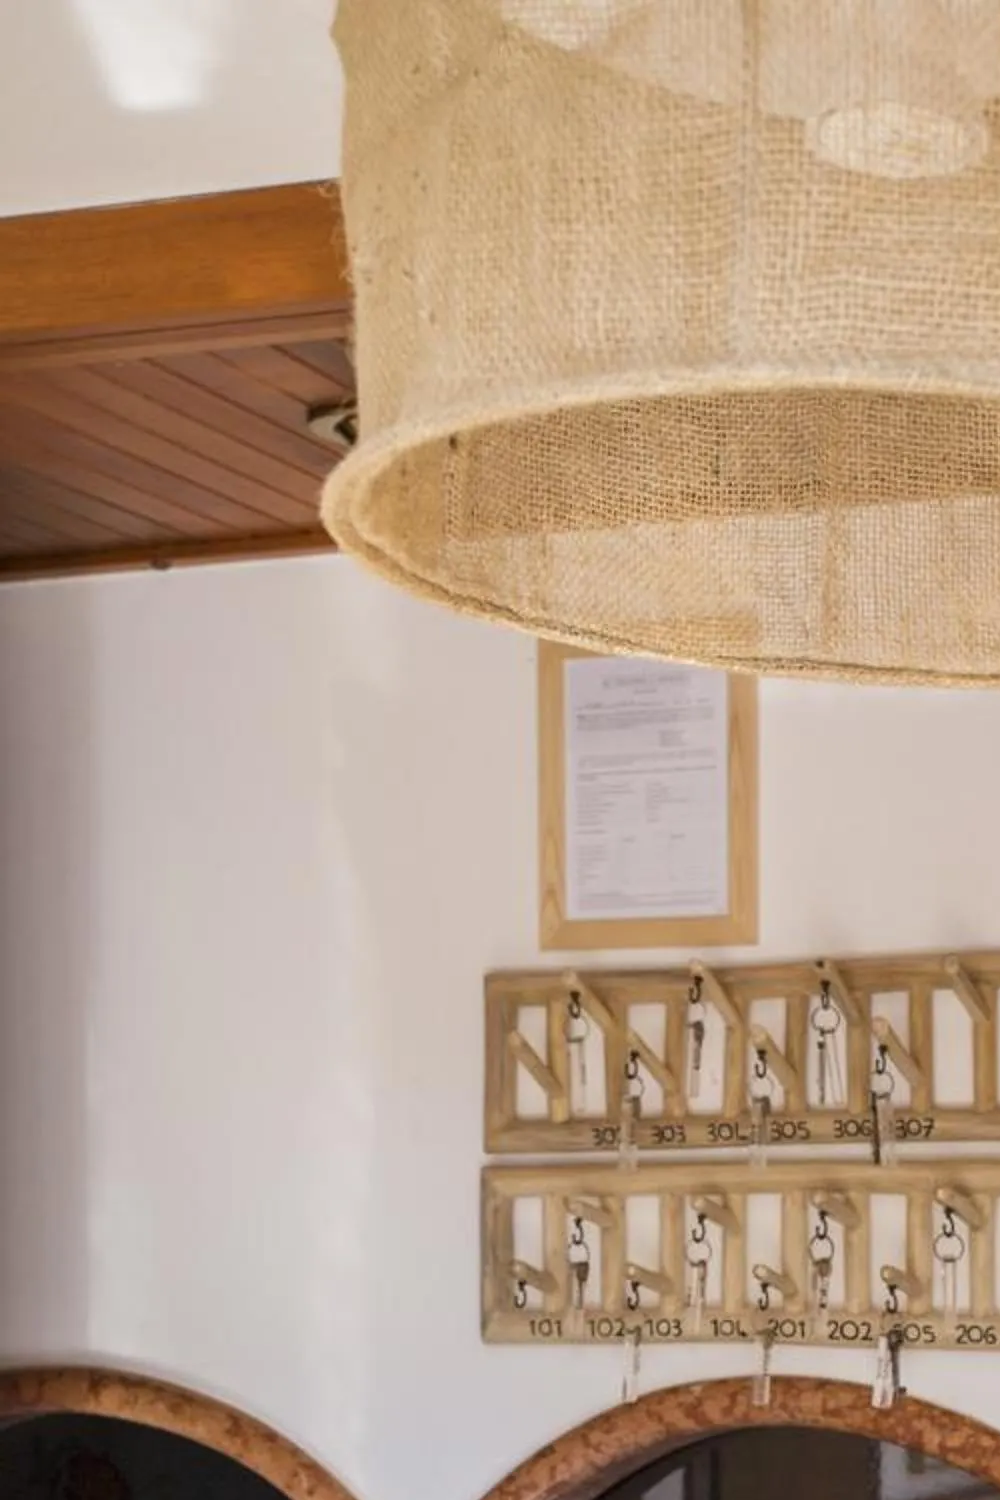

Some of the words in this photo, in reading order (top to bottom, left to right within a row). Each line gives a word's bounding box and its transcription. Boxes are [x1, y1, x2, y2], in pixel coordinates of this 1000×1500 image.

[591, 1126, 622, 1147] 30
[651, 1123, 686, 1144] 303
[771, 1119, 811, 1141] 305
[833, 1118, 876, 1139] 306
[895, 1117, 936, 1139] 307
[529, 1318, 562, 1338] 101
[587, 1318, 624, 1338] 102
[645, 1318, 683, 1338] 103
[710, 1319, 757, 1338] 104
[827, 1320, 873, 1341] 202
[955, 1324, 998, 1345] 206
